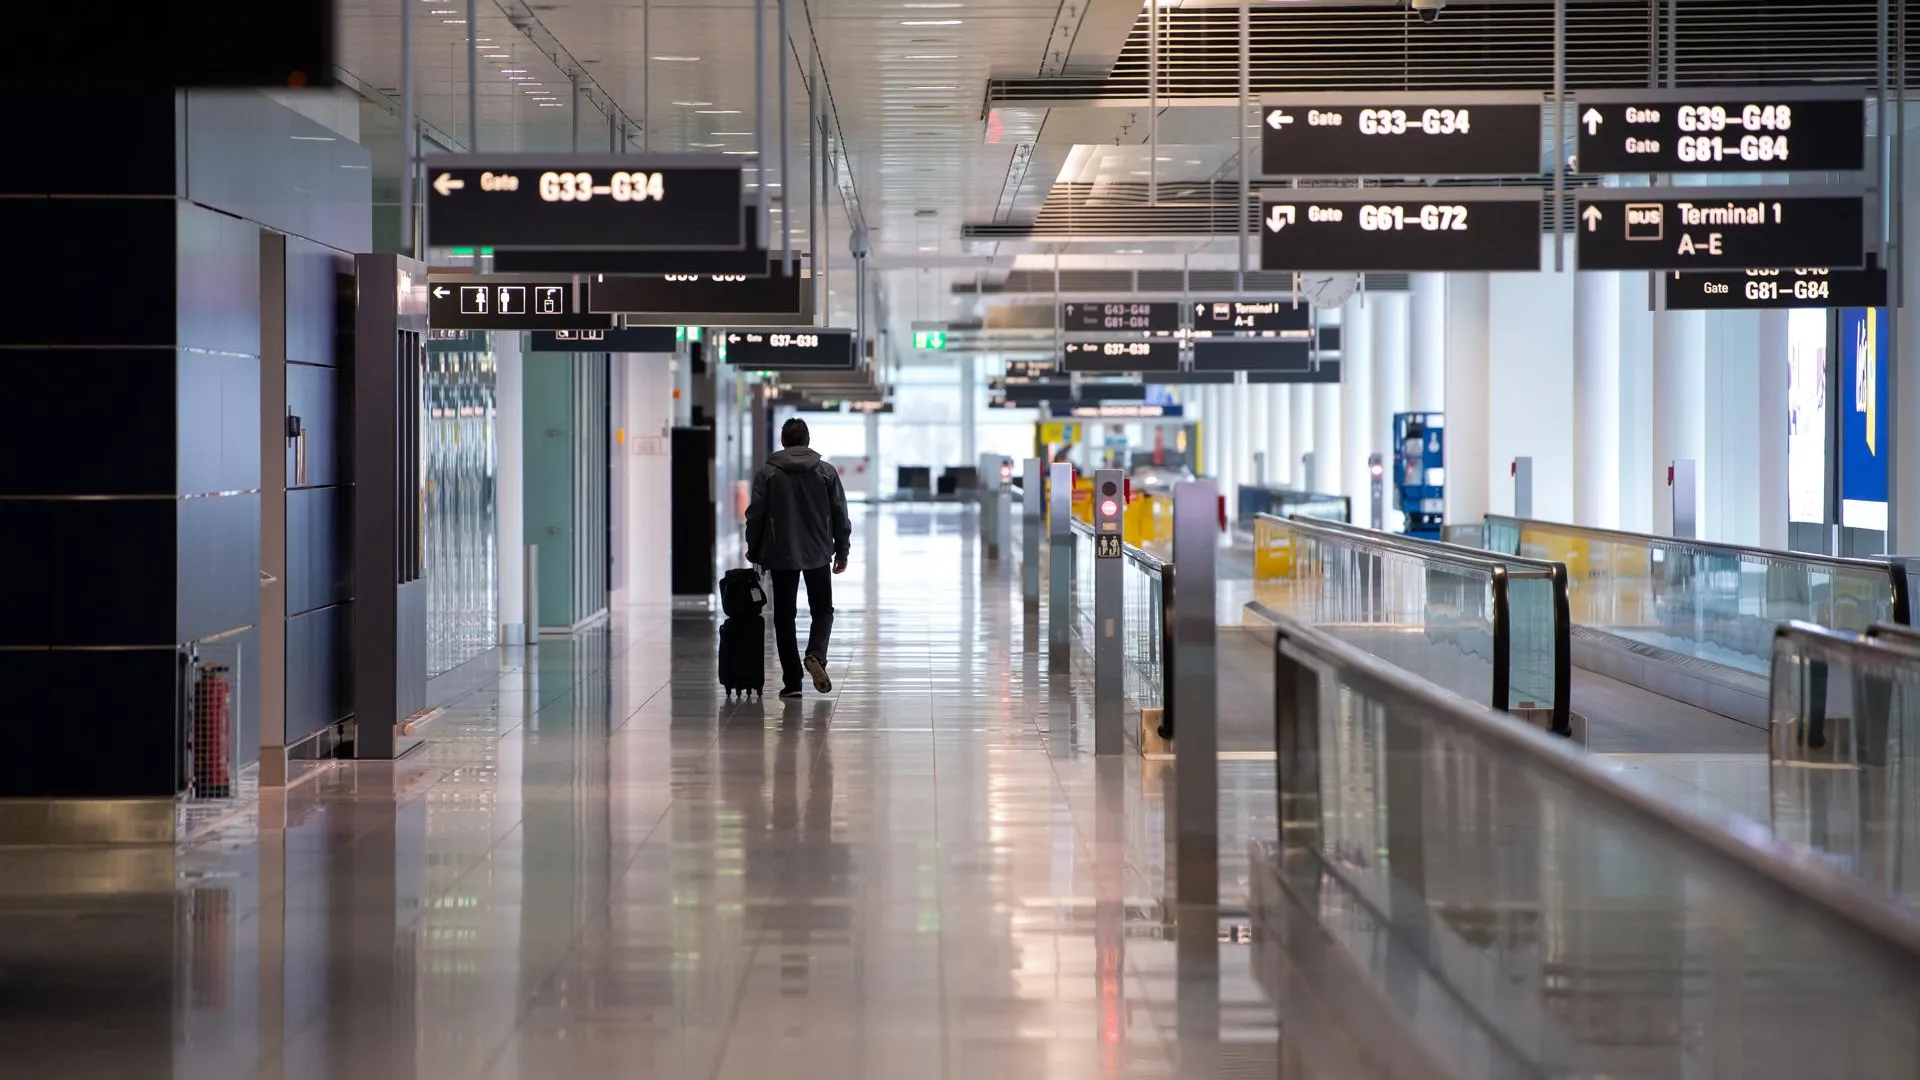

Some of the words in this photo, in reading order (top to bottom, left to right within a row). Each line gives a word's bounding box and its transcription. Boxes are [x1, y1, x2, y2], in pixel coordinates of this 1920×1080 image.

[1308, 110, 1343, 126] Gate
[1359, 109, 1469, 135] G33–G34
[1626, 107, 1660, 123] Gate
[1677, 104, 1792, 132] G39–G48
[1626, 137, 1661, 154] Gate
[1677, 135, 1789, 162] G81–G84
[480, 172, 519, 192] Gate
[539, 171, 665, 202] G33–G34
[1308, 206, 1343, 222] Gate
[1359, 205, 1468, 231] G61–G72
[1678, 202, 1765, 225] Terminal
[1772, 202, 1782, 224] 1
[1678, 233, 1723, 255] A–E
[1703, 282, 1729, 294] Gate
[1745, 280, 1830, 300] G81–G84
